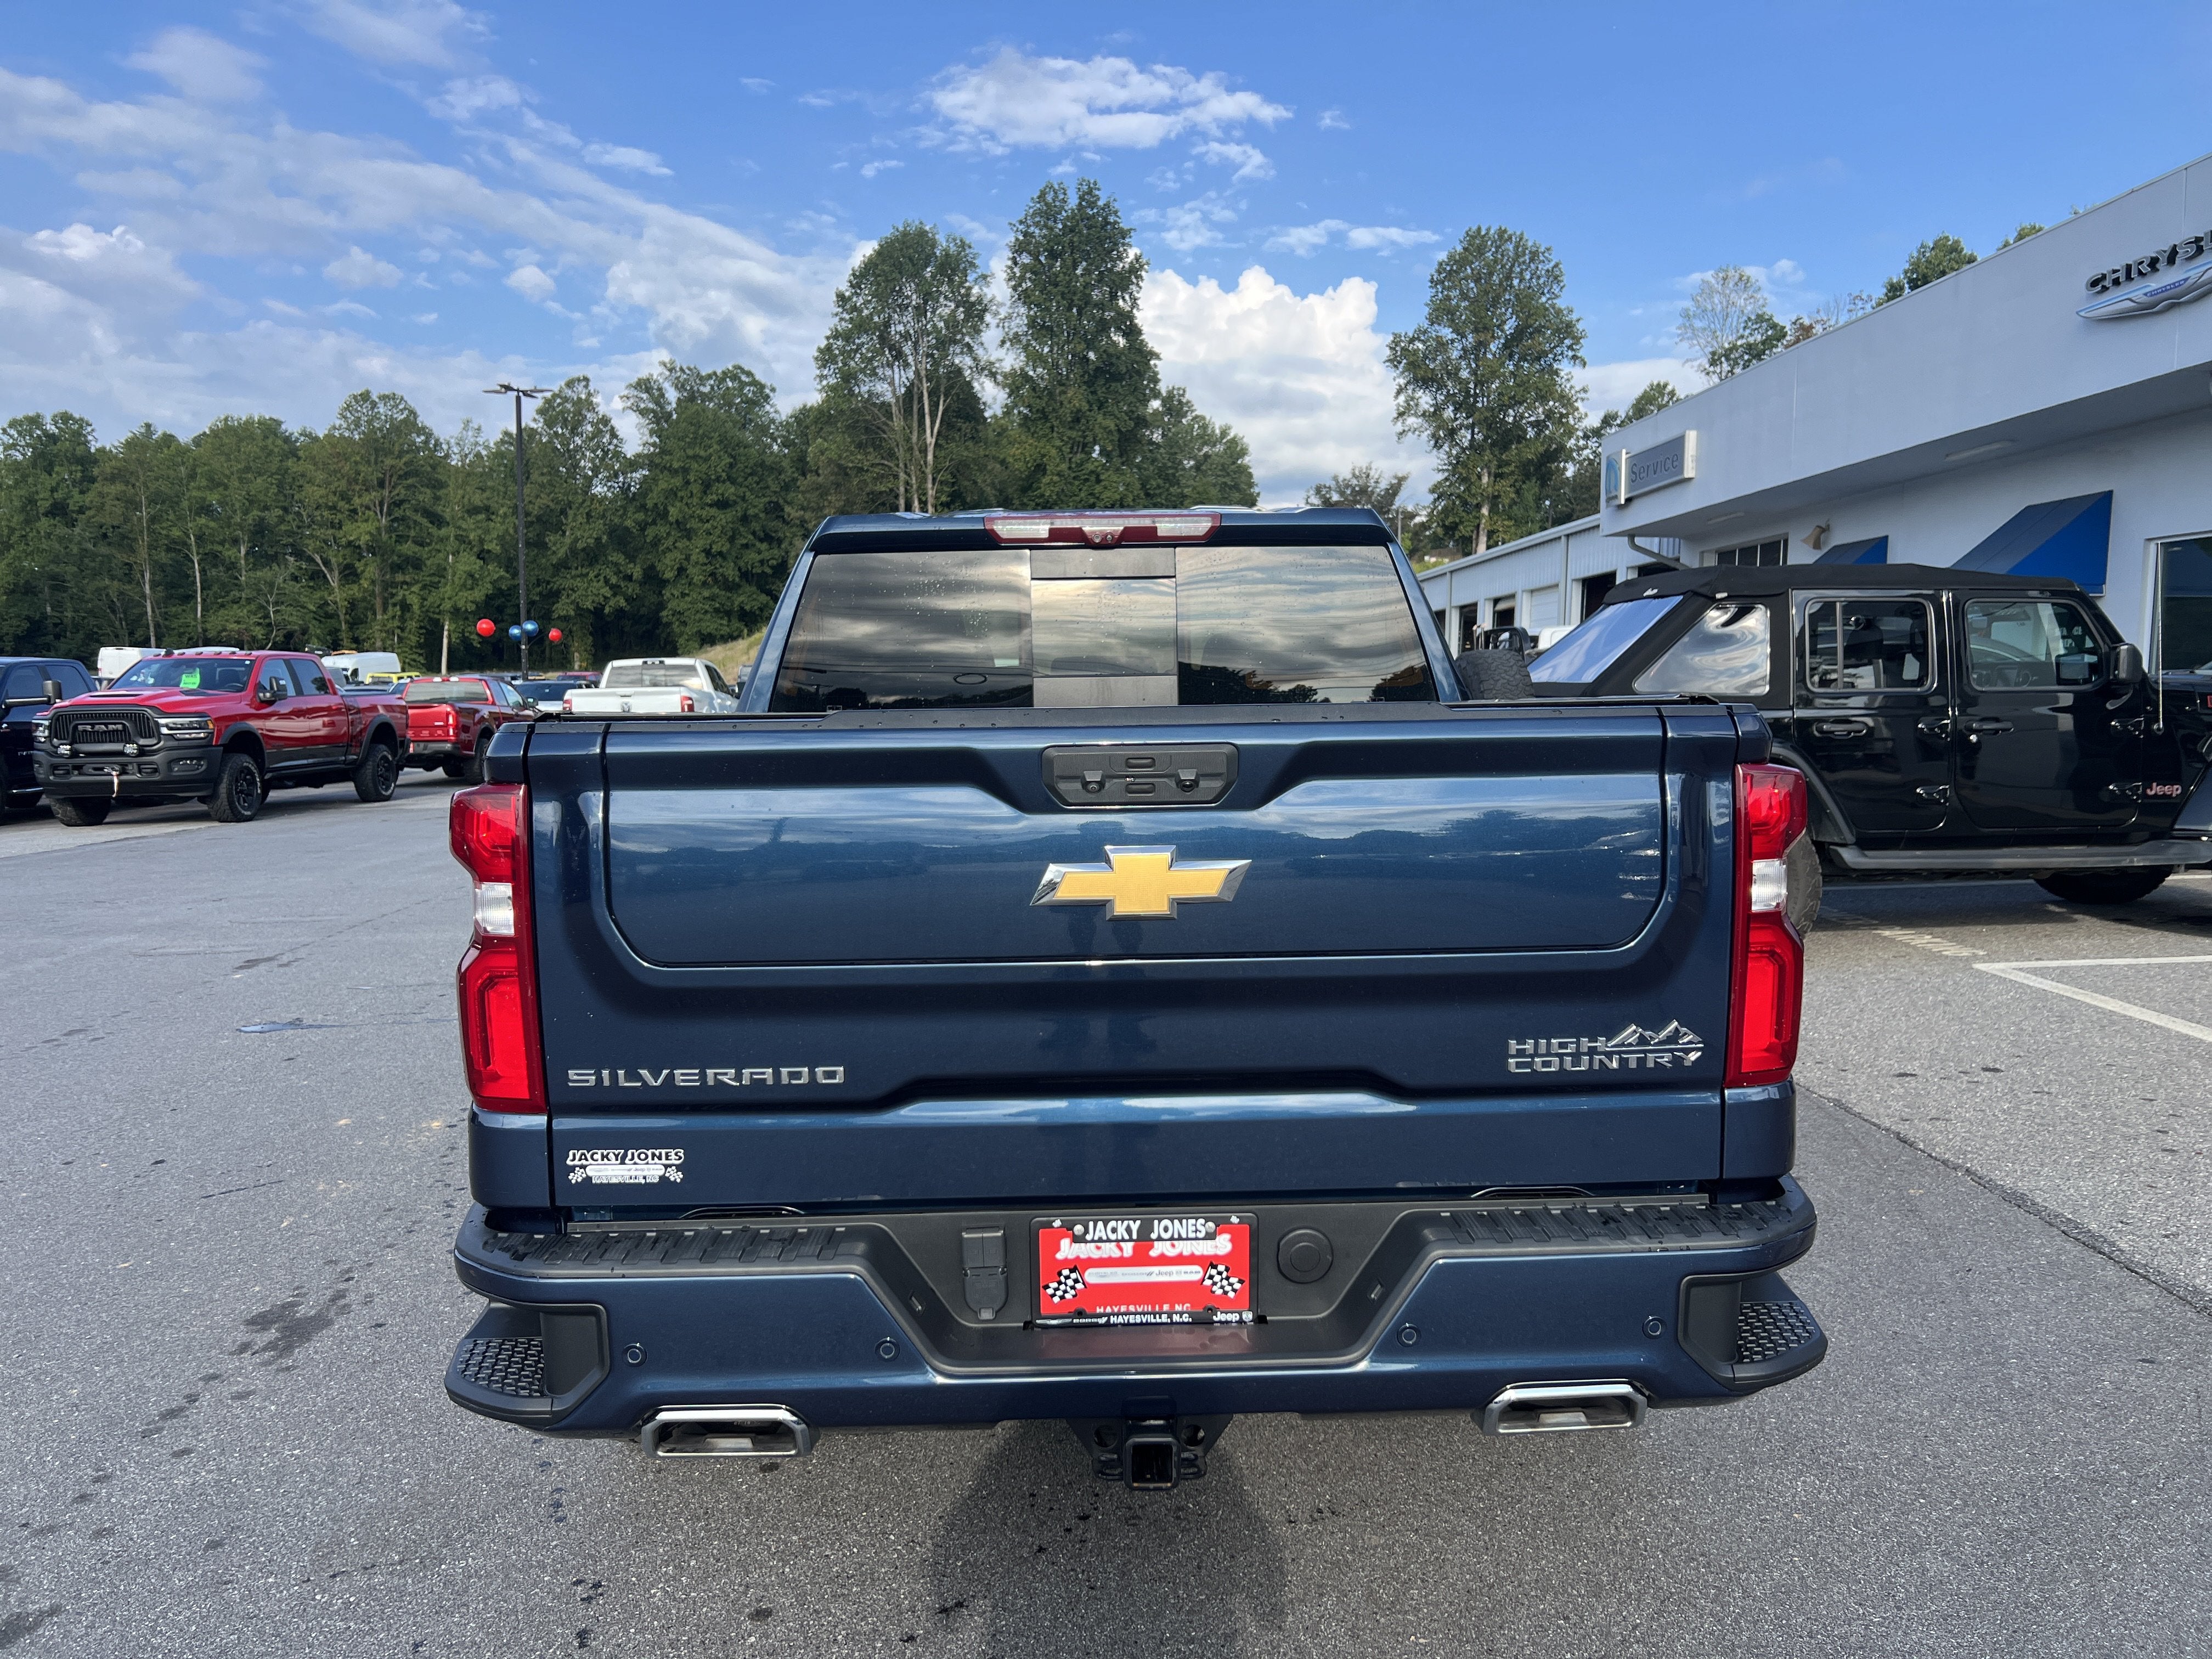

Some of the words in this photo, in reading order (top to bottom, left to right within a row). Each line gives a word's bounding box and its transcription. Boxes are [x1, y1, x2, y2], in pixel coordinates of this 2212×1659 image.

[1630, 453, 1679, 483] Service
[2146, 782, 2182, 797] Jeep
[1508, 1037, 1606, 1054] HIGH
[1508, 1050, 1702, 1073] COUNTRY
[567, 1066, 845, 1087] SILVERADO
[567, 1150, 624, 1164] JACKY
[625, 1149, 684, 1164] JONES
[1085, 1220, 1141, 1241] JACKY
[1150, 1218, 1206, 1239] JONES
[1056, 1238, 1135, 1260] JACKY
[1148, 1233, 1233, 1257] JONES
[1110, 1314, 1171, 1324] HAYESVILLE,
[1173, 1313, 1192, 1323] N.C.
[1212, 1311, 1240, 1323] Jeep
